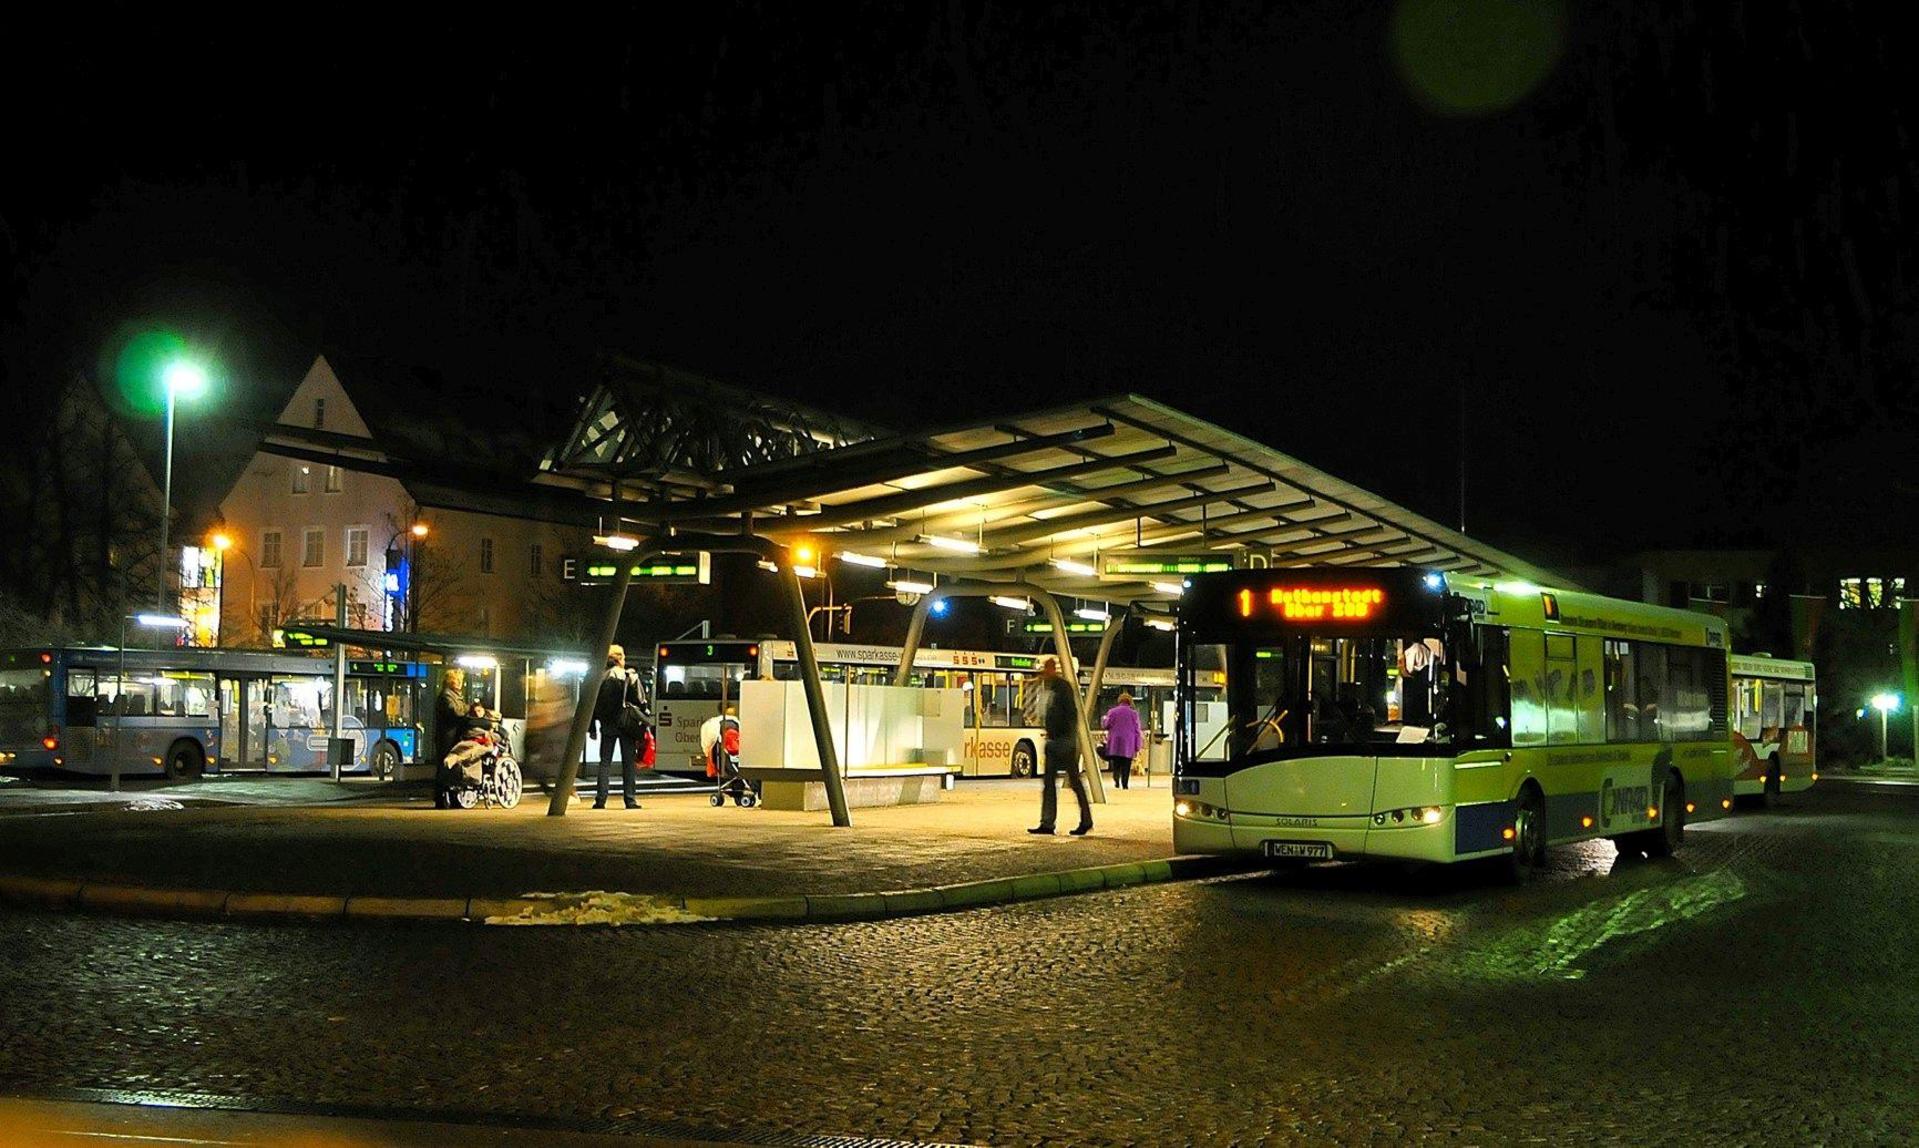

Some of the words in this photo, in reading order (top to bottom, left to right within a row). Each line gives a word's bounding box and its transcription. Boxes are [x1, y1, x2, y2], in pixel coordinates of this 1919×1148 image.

[564, 559, 576, 579] E
[1250, 554, 1268, 569] D
[1240, 589, 1250, 617] 1
[1006, 619, 1016, 634] F
[707, 645, 714, 656] 3
